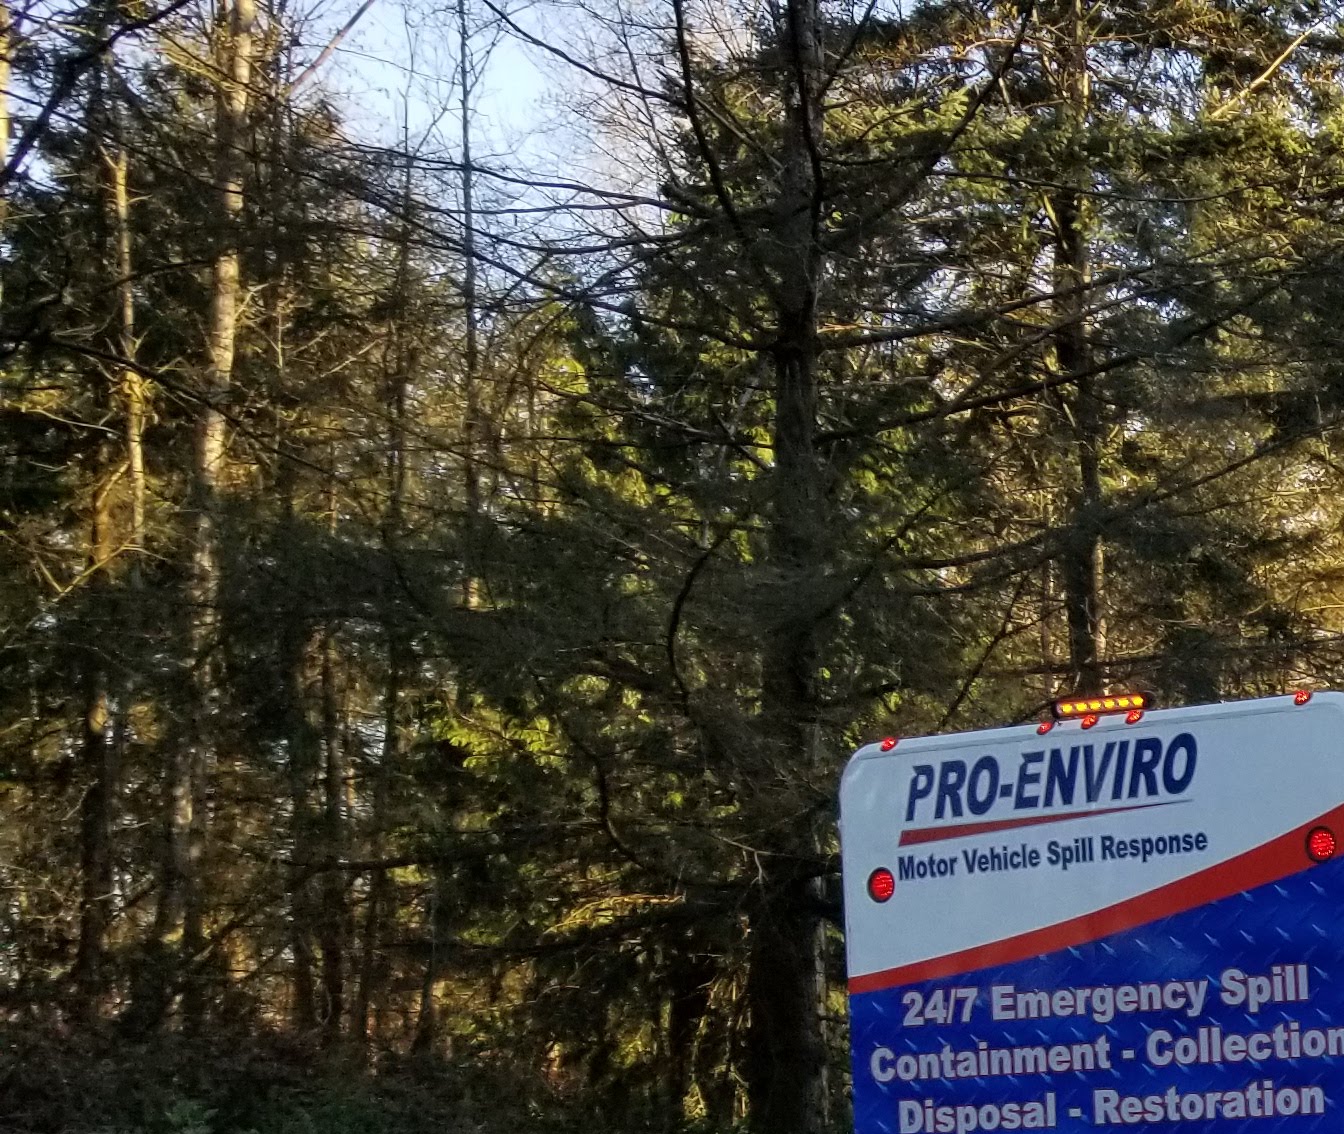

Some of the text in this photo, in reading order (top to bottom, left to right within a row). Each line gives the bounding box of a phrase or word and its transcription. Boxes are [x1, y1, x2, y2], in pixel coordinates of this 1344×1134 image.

[905, 732, 1198, 822] PRO-ENVIRO
[899, 832, 1208, 881] Motor Vehicle Spill Response
[902, 964, 1309, 1028] 24/7 Emergency Spill
[870, 1035, 1110, 1083] Containment
[1093, 1080, 1325, 1126] Restoration
